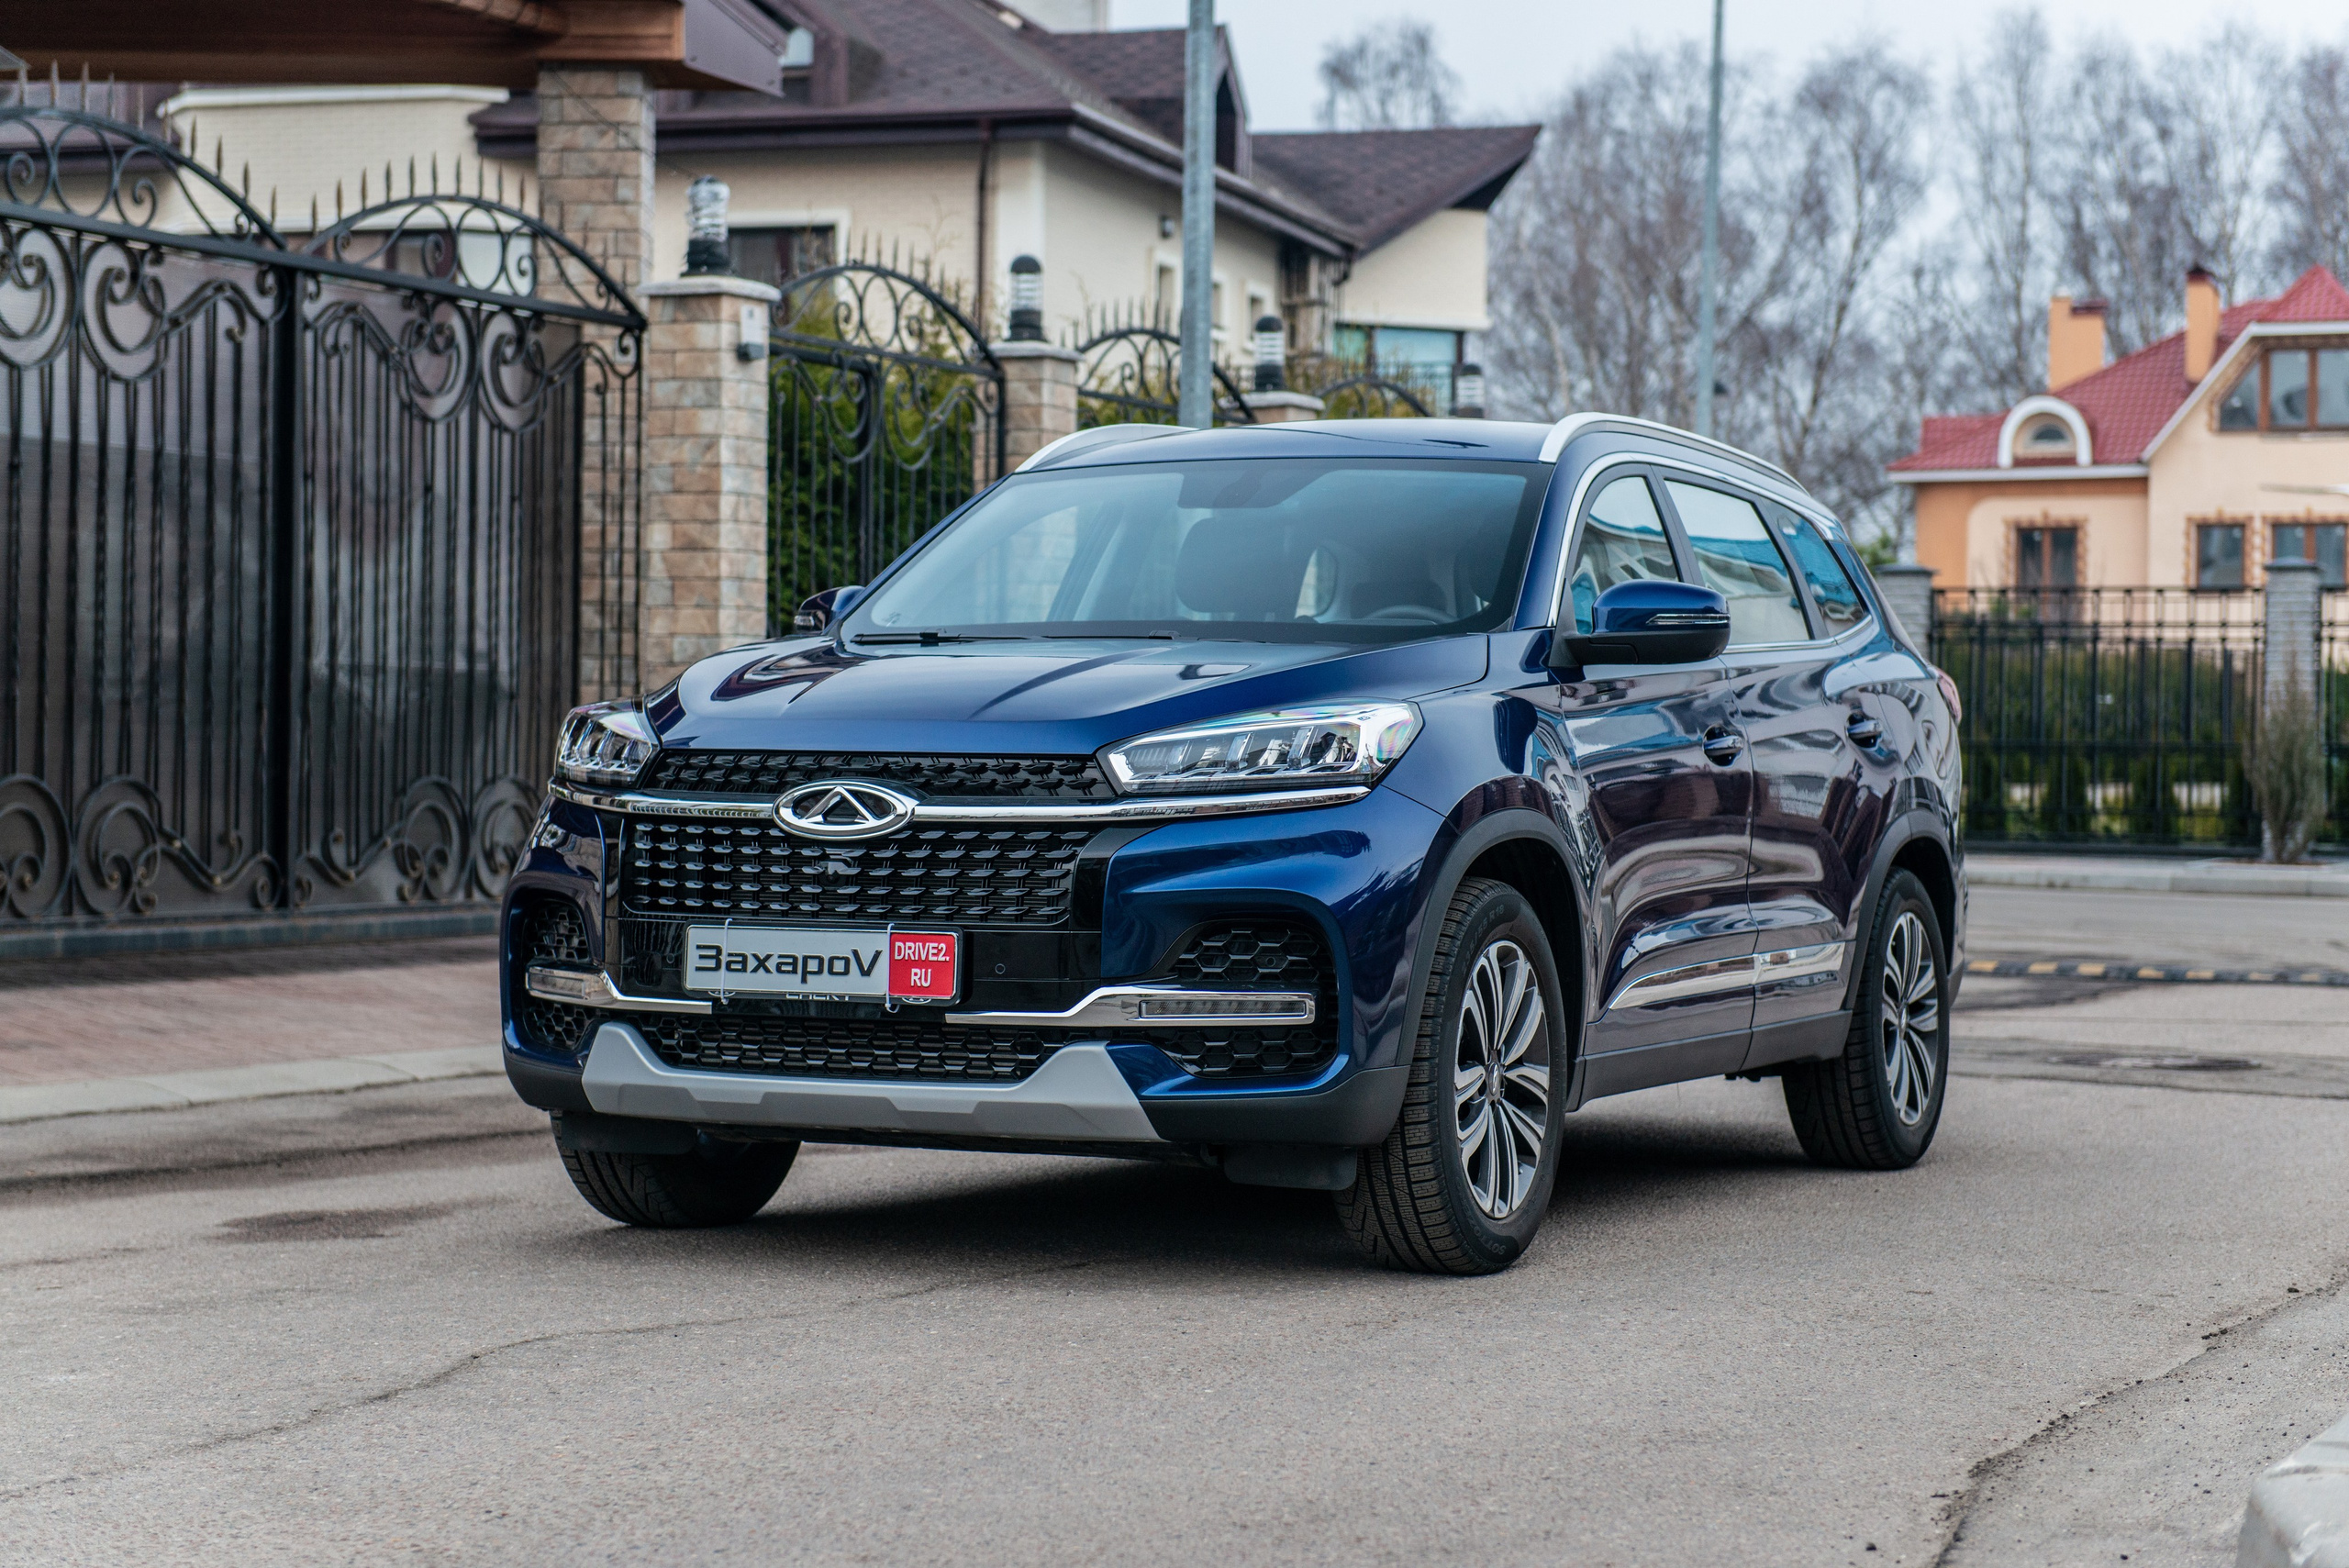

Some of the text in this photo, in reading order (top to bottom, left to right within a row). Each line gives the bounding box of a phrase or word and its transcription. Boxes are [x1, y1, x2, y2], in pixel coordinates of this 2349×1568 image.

[1488, 904, 1505, 923] R18
[894, 941, 950, 962] DRIVE2.
[910, 968, 931, 987] RU
